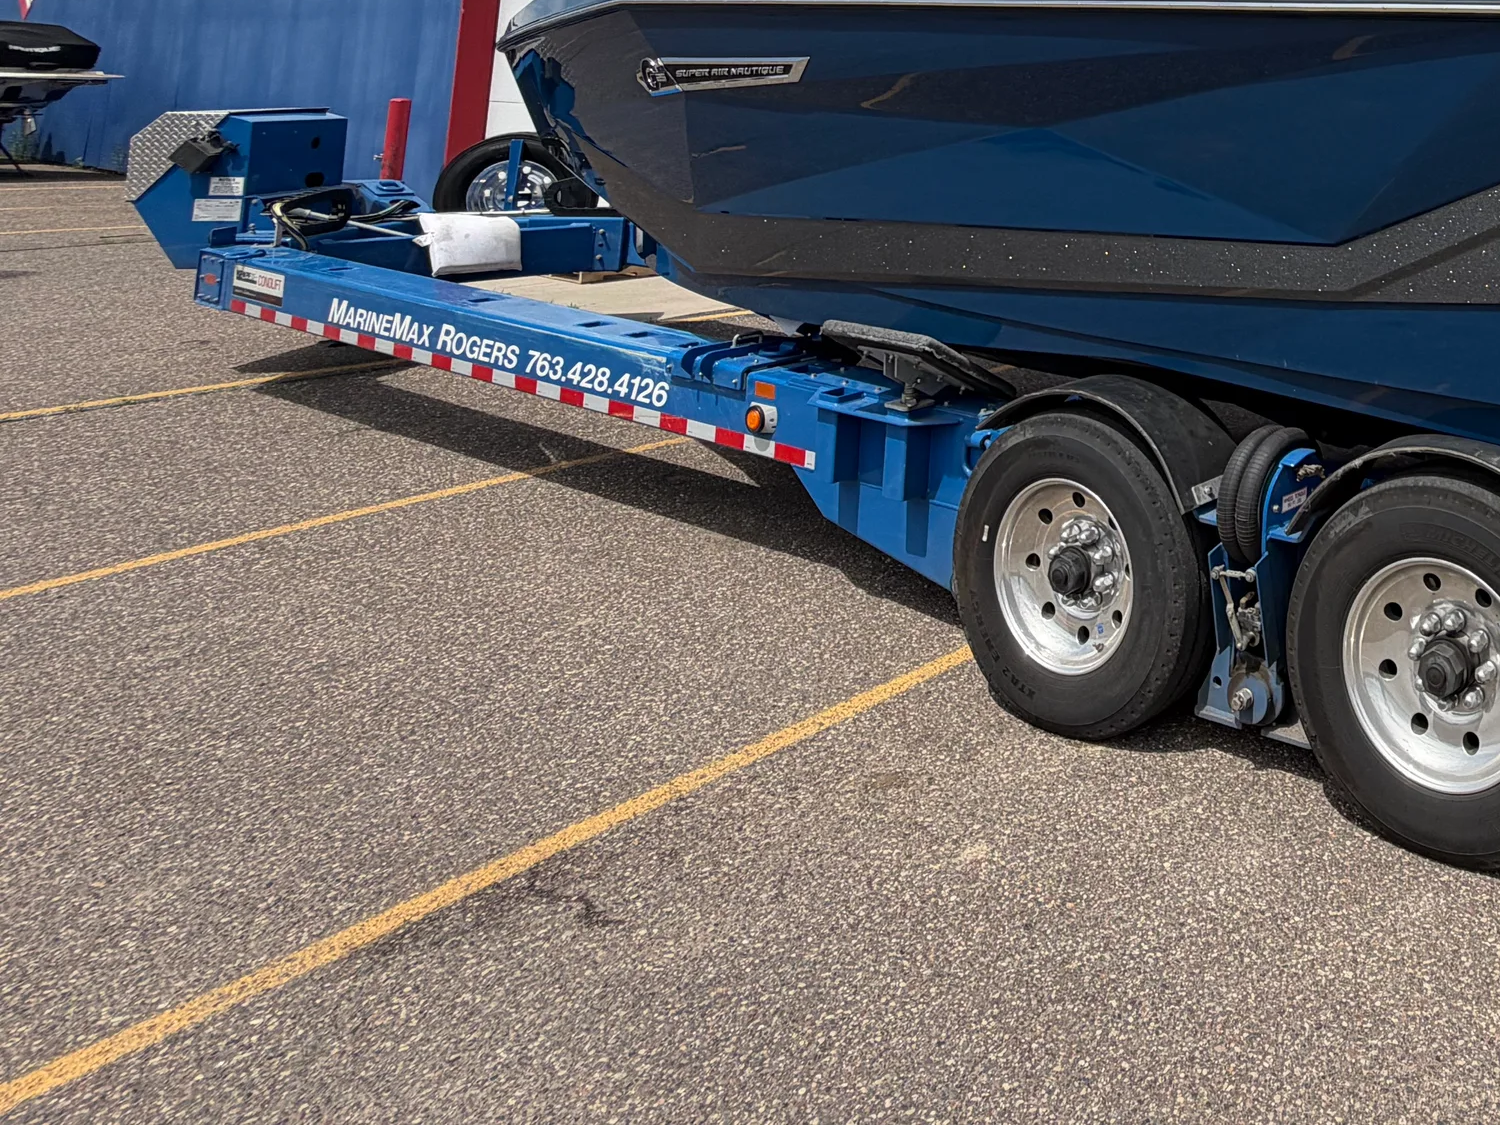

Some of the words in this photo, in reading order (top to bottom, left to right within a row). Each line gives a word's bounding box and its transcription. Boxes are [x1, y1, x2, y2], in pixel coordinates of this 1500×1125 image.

[675, 68, 709, 78] SUPER
[710, 68, 729, 77] AIR
[730, 65, 785, 76] NAUTIQUE
[524, 349, 671, 408] 763.428.4126
